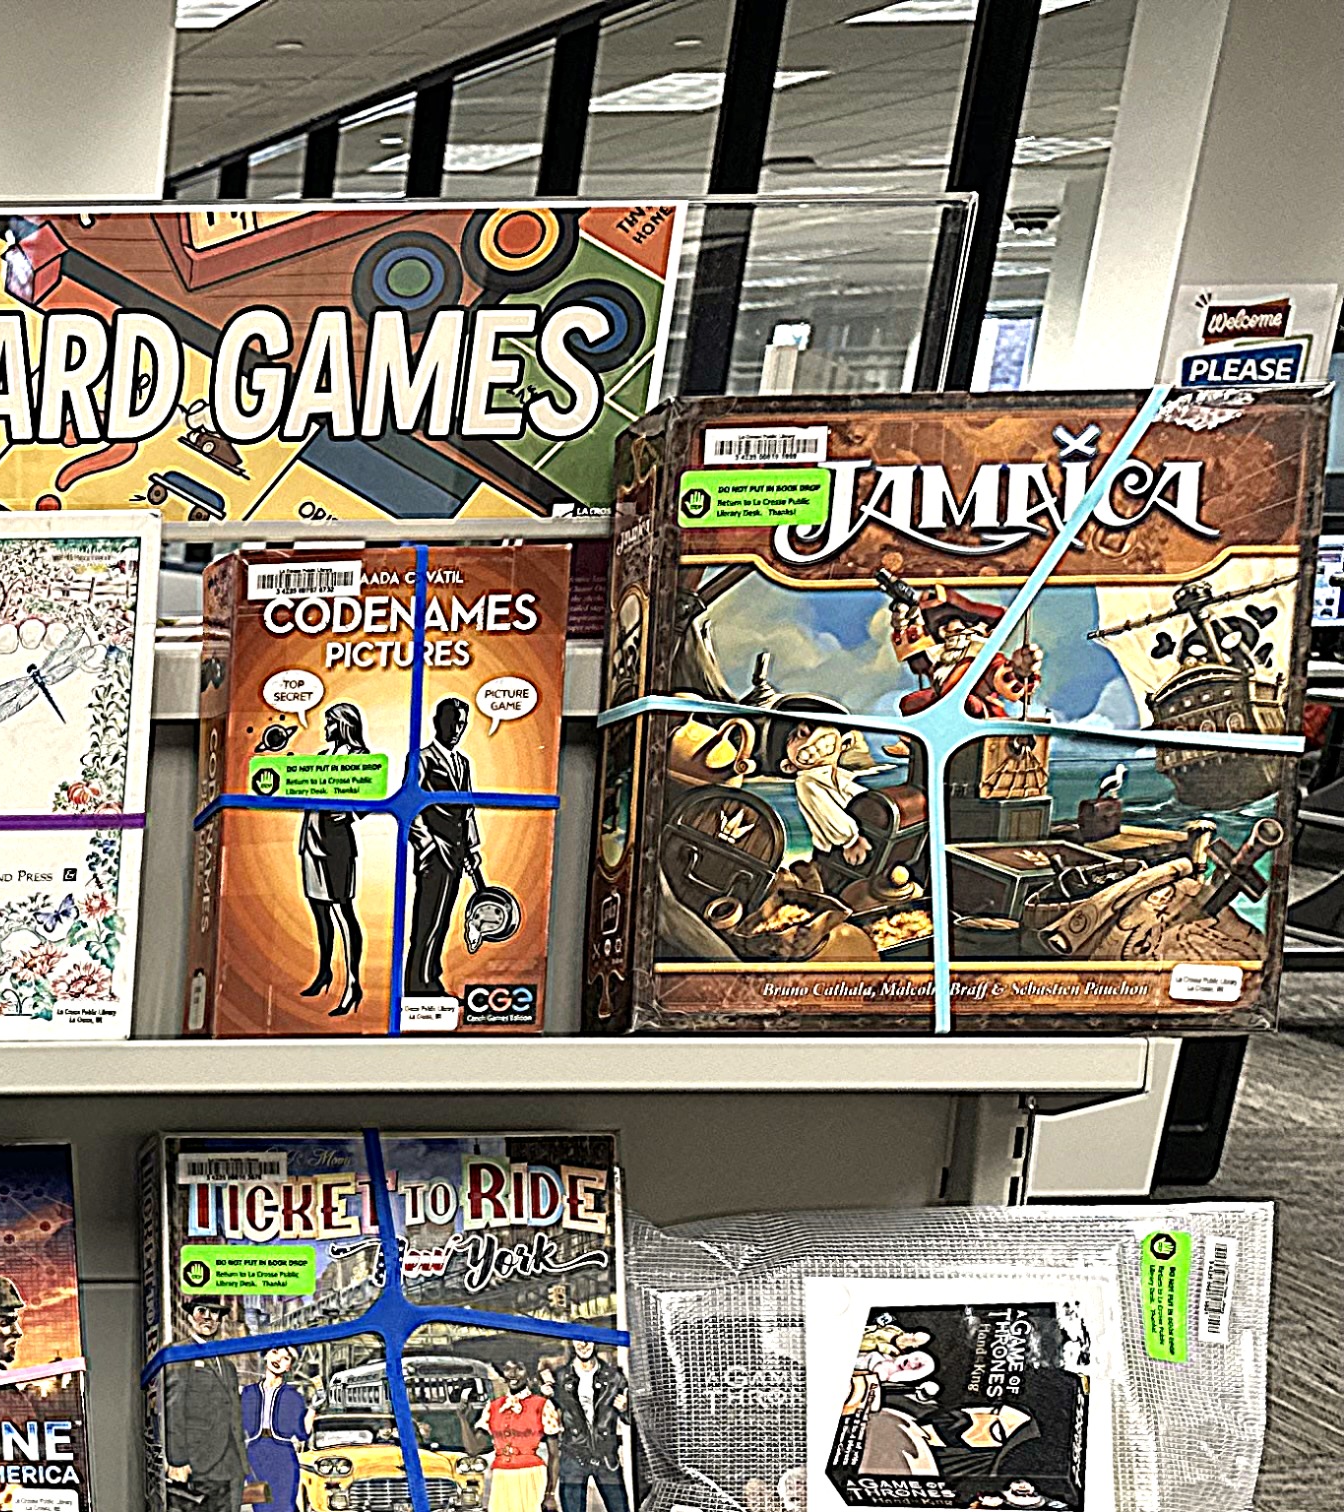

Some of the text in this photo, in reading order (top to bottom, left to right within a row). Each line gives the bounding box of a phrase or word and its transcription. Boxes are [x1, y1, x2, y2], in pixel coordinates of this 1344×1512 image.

[1208, 309, 1282, 333] Welcome
[212, 306, 609, 444] GAMES
[1189, 358, 1294, 381] PLEASE
[263, 594, 538, 634] CODENAMES
[325, 641, 471, 669] PICTURES
[283, 679, 305, 690] TOP
[484, 688, 529, 701] PICTURE
[274, 690, 313, 703] SECRET
[491, 701, 522, 711] GAME
[762, 981, 1148, 999] Bruno Cathala, & Pauchon
[406, 1161, 608, 1232] TO RIDE
[851, 1486, 956, 1500] THRONES
